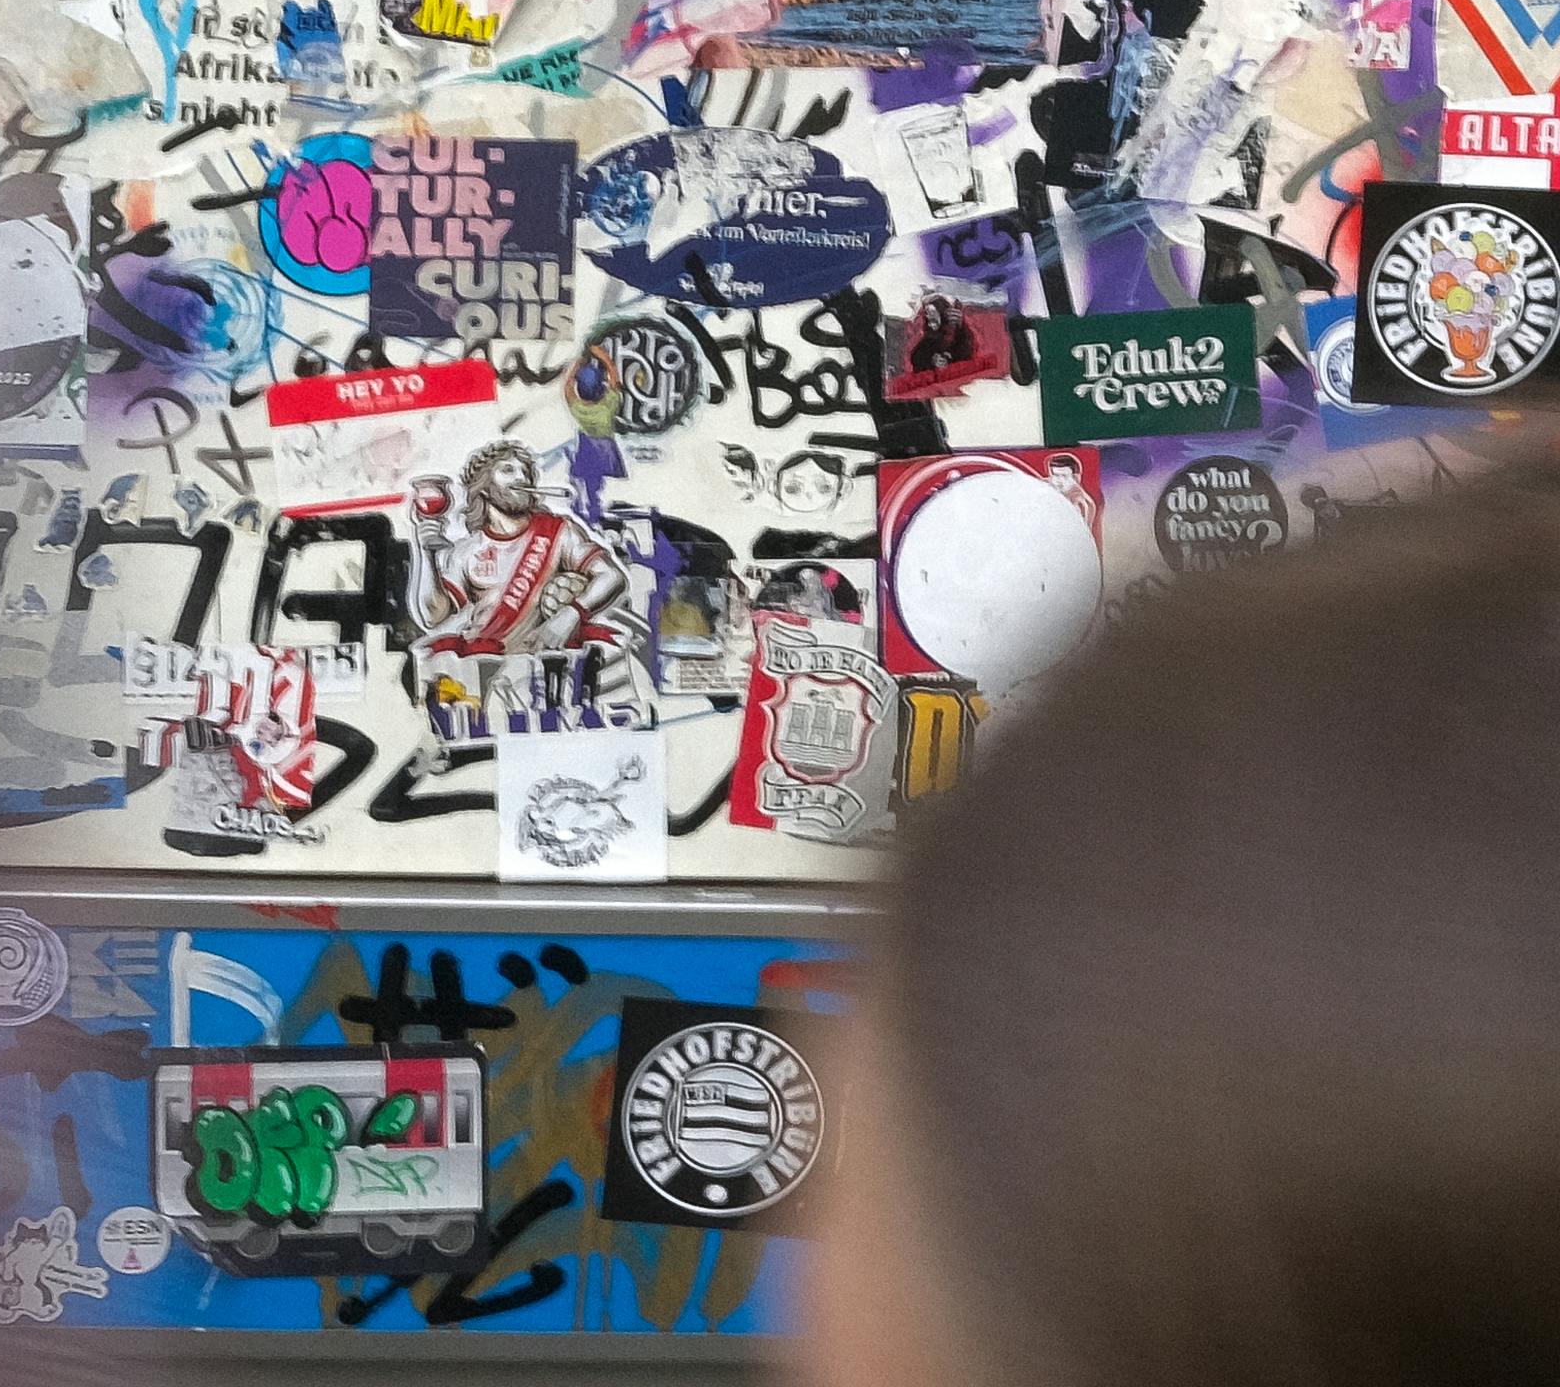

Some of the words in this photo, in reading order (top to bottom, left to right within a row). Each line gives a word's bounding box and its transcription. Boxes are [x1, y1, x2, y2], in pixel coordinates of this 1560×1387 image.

[369, 218, 509, 258] ALLY
[464, 301, 575, 341] OUS
[1072, 338, 1226, 379] Eduk2
[336, 377, 383, 401] HEY
[391, 373, 426, 396] YO
[1188, 466, 1253, 491] what
[1166, 487, 1200, 511] do
[1207, 487, 1271, 518] you
